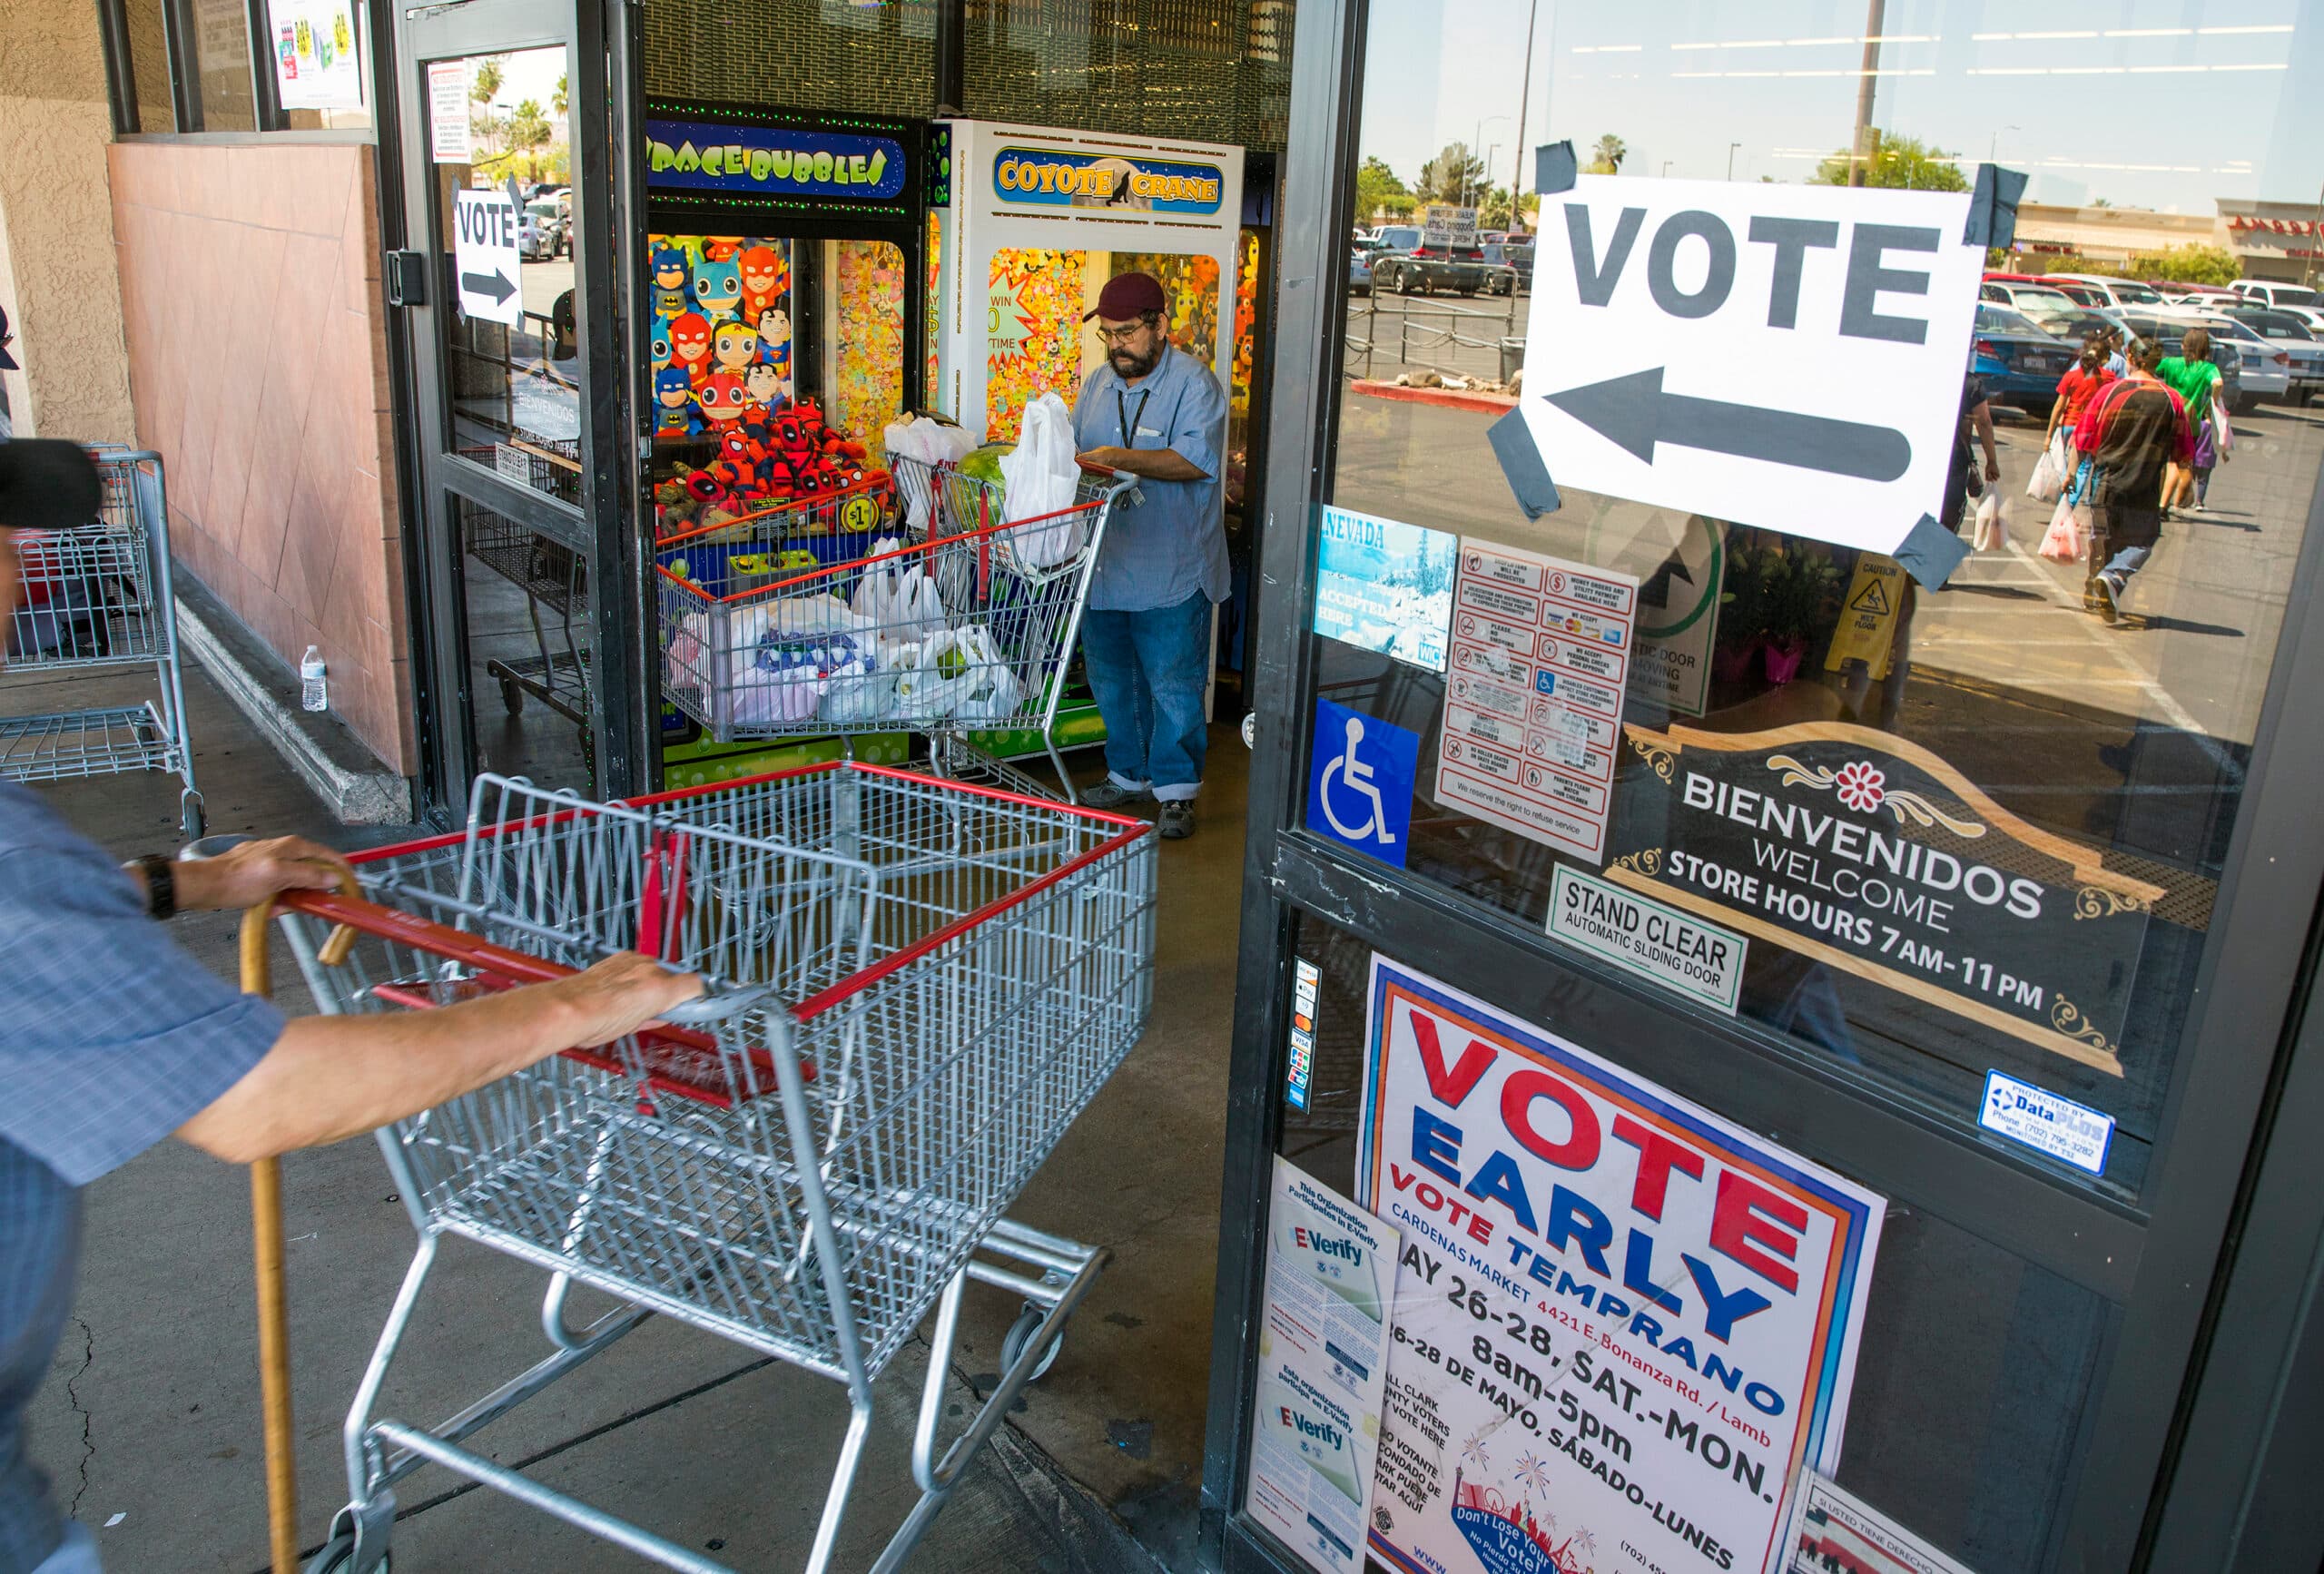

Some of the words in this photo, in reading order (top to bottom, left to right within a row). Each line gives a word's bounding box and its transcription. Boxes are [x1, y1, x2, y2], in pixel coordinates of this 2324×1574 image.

[646, 135, 743, 177] PACE
[749, 148, 888, 186] BUBBLES
[999, 157, 1114, 197] COYOTE
[1132, 171, 1218, 204] CRANE
[458, 202, 515, 248] VOTE
[1562, 202, 1943, 346] VOTE
[990, 296, 1011, 307] WIN
[1325, 511, 1384, 550] NEVADA
[1571, 576, 1590, 586] MONEY
[1590, 581, 1612, 592] ORDERS
[1863, 564, 1897, 577] CAUTION
[1319, 587, 1388, 616] ACCEPTED
[1574, 585, 1594, 595] UTILITY
[1594, 590, 1620, 601] PAYMENT
[1574, 592, 1601, 604] AVAILABLE
[1603, 599, 1618, 608] HERE
[1318, 605, 1354, 626] HERE
[1491, 624, 1512, 633] PLEASE
[1580, 614, 1598, 623] ACCEPT
[1855, 620, 1876, 631] FLOOR
[1861, 615, 1875, 623] WET
[1420, 643, 1441, 664] WIC
[1490, 636, 1515, 648] SMOKING
[1567, 652, 1590, 664] PERSONAL
[1584, 650, 1602, 659] ACCEPT
[1659, 649, 1695, 668] DOOR
[1582, 664, 1606, 675] APPROVAL
[1470, 726, 1499, 741] REQUIRED
[1553, 789, 1565, 797] YOUR
[1566, 792, 1588, 805] CHILDREN
[1554, 776, 1573, 787] PARENTS
[1574, 782, 1590, 793] PLEASE
[1563, 786, 1580, 795] WATCH
[1457, 782, 1468, 792] We
[1469, 788, 1493, 802] reserve
[1494, 795, 1505, 807] the
[1507, 802, 1523, 813] right
[1523, 807, 1531, 816] to
[1532, 811, 1554, 825] refuse
[1554, 820, 1581, 835] service
[1683, 772, 2045, 920] BIENVENIDOS
[1668, 851, 1759, 905] STORE
[1764, 884, 1874, 946] HOURS
[1752, 837, 1954, 934] WELCOME
[1565, 881, 1640, 933] STAND
[1646, 915, 1728, 971] CLEAR
[1565, 911, 1630, 949] AUTOMATIC
[1633, 939, 1681, 970] SLIDING
[1684, 961, 1721, 989] DOOR
[2013, 1085, 2069, 1112] PROTECTED
[2072, 1109, 2085, 1118] BY
[1993, 1109, 2020, 1127] Phone
[2024, 1123, 2048, 1139] (702)
[2051, 1133, 2094, 1158] 795-3282
[2006, 1125, 2048, 1147] MONITORED
[2048, 1143, 2059, 1151] BY
[1409, 1008, 1809, 1296] VOTE
[1289, 1184, 1336, 1222] Participates
[1337, 1214, 1345, 1228] in
[1347, 1224, 1378, 1251] E-Verify
[1299, 1181, 1315, 1198] This
[1316, 1193, 1368, 1232] Organization
[1412, 1105, 1772, 1345] EARLY
[1390, 1162, 1494, 1246] VOTE
[1507, 1235, 1786, 1417] TEMPRANO
[1392, 1203, 1467, 1262] CARDENAS
[1469, 1254, 1531, 1303] MARKET
[1537, 1301, 1579, 1333] 4421
[1600, 1333, 1673, 1387] Bonanza
[1677, 1380, 1703, 1407] Rd.
[1720, 1406, 1771, 1448] Lamb
[1391, 1322, 1441, 1363] 6-28
[1445, 1357, 1475, 1386] DE
[1478, 1378, 1541, 1437] MAYO,
[1398, 1243, 1443, 1286] AY
[1448, 1275, 1561, 1368] 26-28,
[1571, 1351, 1773, 1503] SAT.-MON.
[1283, 1363, 1299, 1382] Esta
[1301, 1379, 1350, 1421] organización
[1403, 1384, 1439, 1412] CLARK
[1472, 1334, 1632, 1464] 8am-5pm
[1312, 1398, 1322, 1410] en
[1324, 1405, 1354, 1434] E-Verify
[1392, 1402, 1418, 1429] VOTE
[1421, 1423, 1446, 1451] HERE
[1413, 1402, 1451, 1437] VOTERS
[1379, 1441, 1426, 1483] CONDADO
[1427, 1481, 1442, 1498] DE
[1397, 1438, 1439, 1479] VOTANTE
[1397, 1471, 1429, 1504] PUEDE
[1397, 1490, 1423, 1514] AQUÍ
[1457, 1507, 1489, 1525] Don't
[1492, 1515, 1520, 1540] Lose
[1523, 1532, 1550, 1569] Your
[1470, 1530, 1482, 1545] No
[1483, 1541, 1510, 1566] Pierda
[1498, 1531, 1541, 1573] Vote!
[1620, 1540, 1647, 1567] (702)
[1818, 1498, 1827, 1506] SI
[1827, 1502, 1857, 1527] USTED
[1859, 1524, 1886, 1545] TIENE
[1886, 1540, 1934, 1574] DERECHO
